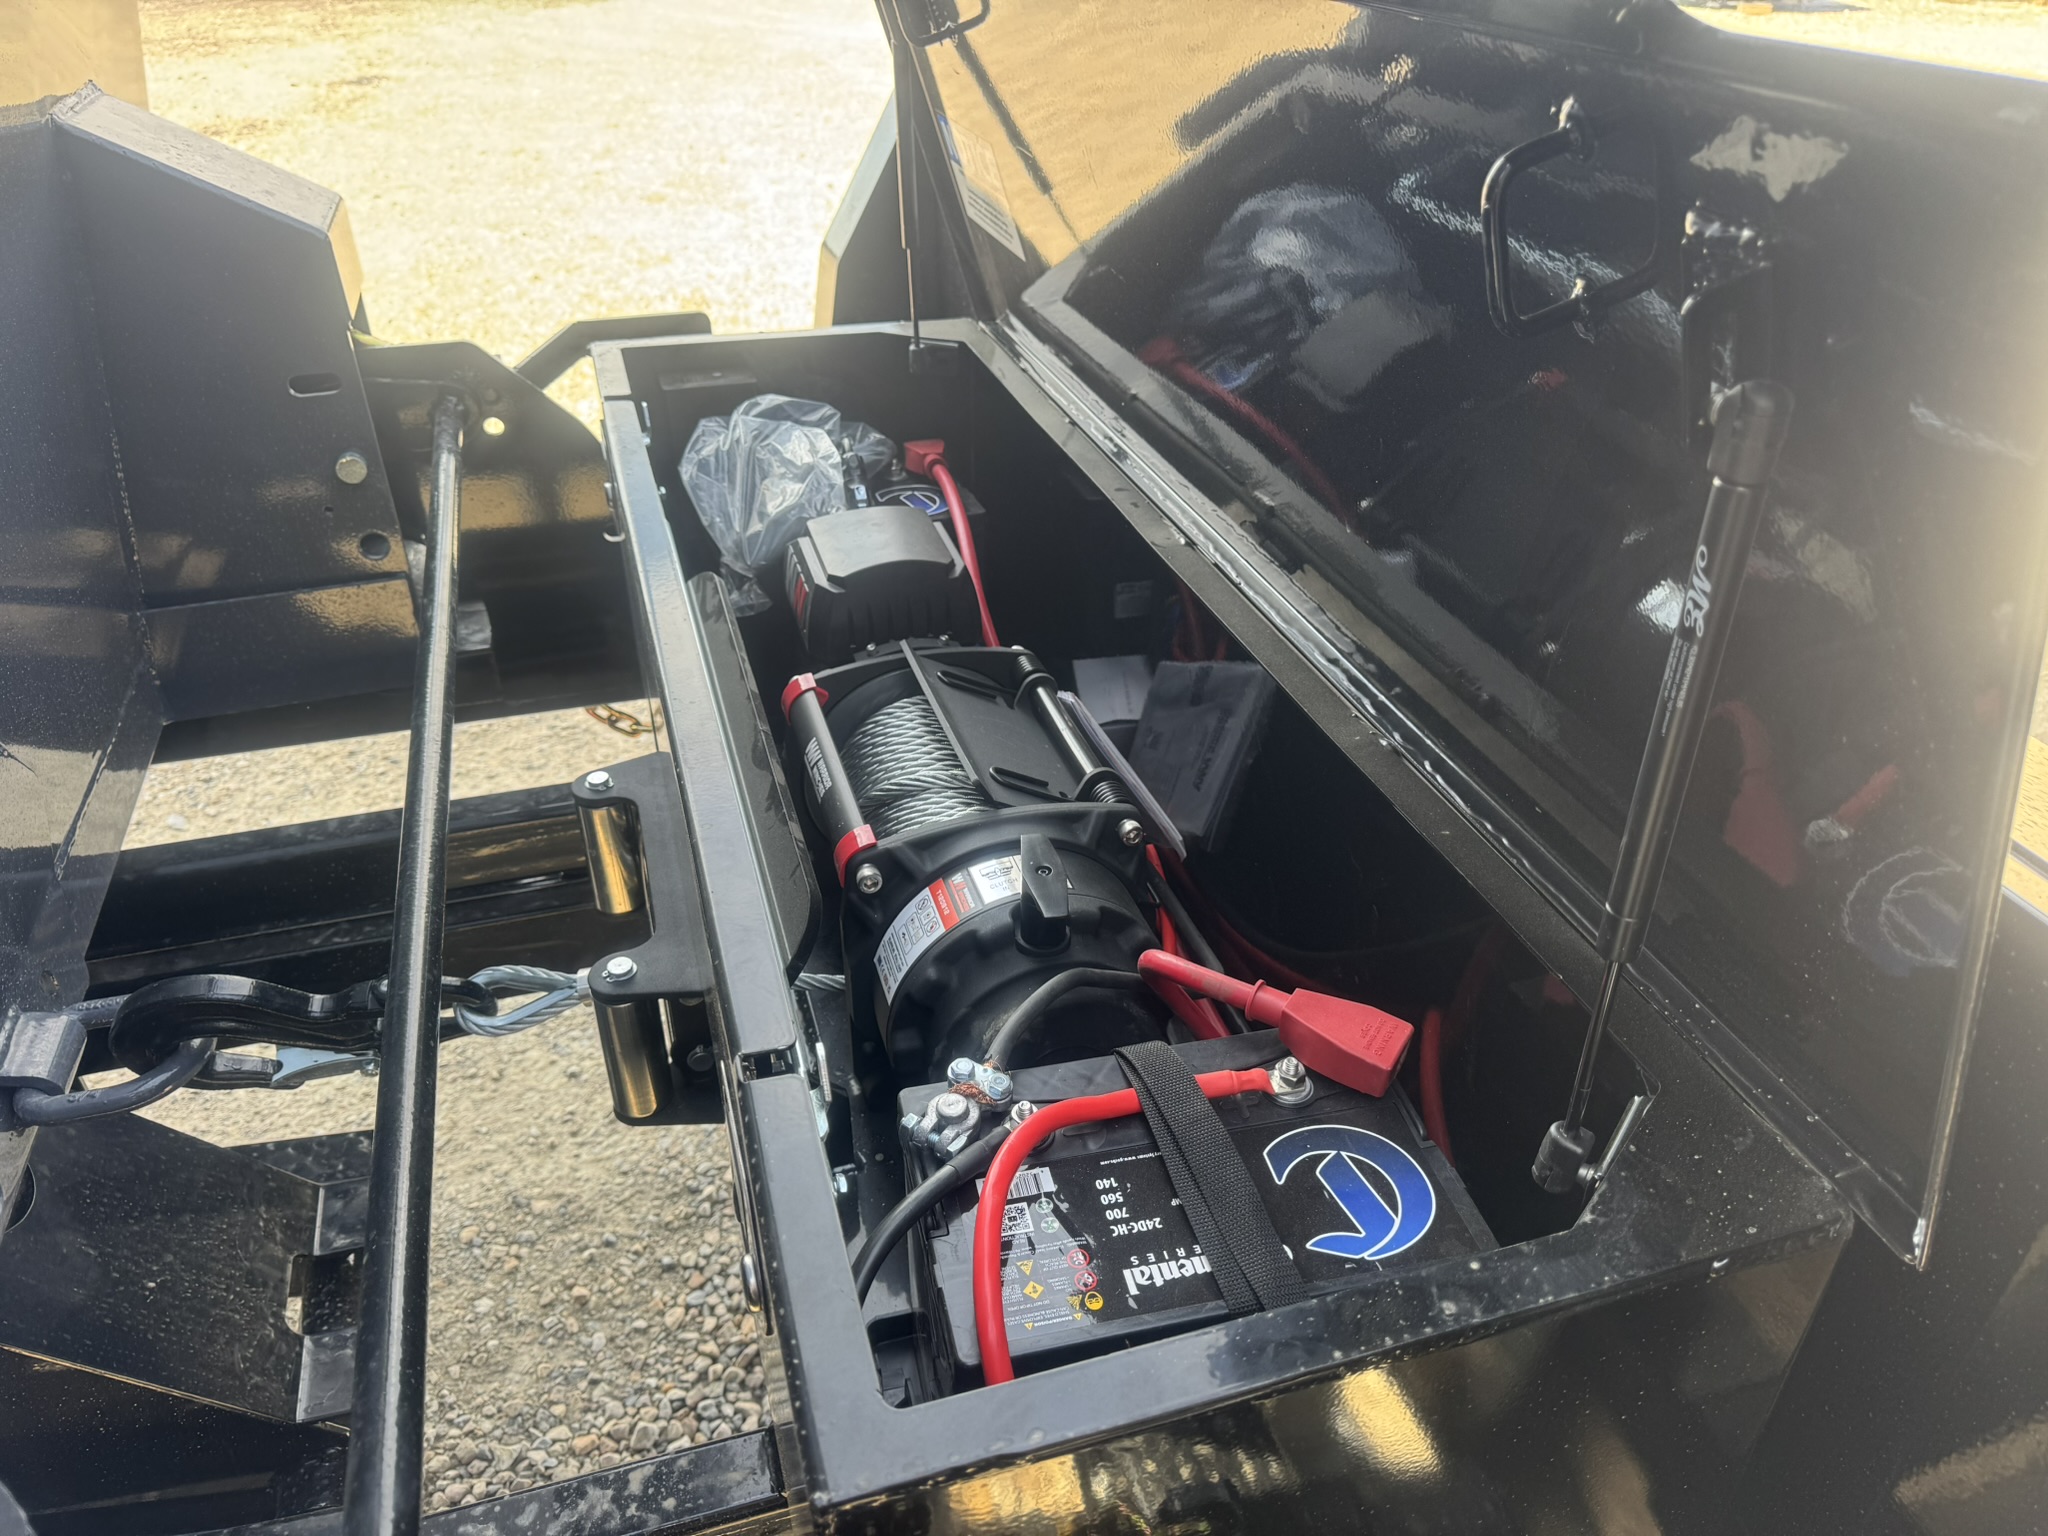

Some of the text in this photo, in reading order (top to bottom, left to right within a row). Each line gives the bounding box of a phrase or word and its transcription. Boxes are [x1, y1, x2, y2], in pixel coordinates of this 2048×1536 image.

[1095, 1177, 1118, 1189] 140
[1100, 1191, 1123, 1204] 560
[1105, 1206, 1129, 1220] 700
[1109, 1217, 1162, 1236] 24DC-HC
[1002, 1232, 1034, 1240] INSTRUCTION
[1130, 1244, 1201, 1265] ERIES
[1020, 1315, 1043, 1323] EXPLOSIVE
[1033, 1315, 1072, 1326] DANGER/POISON
